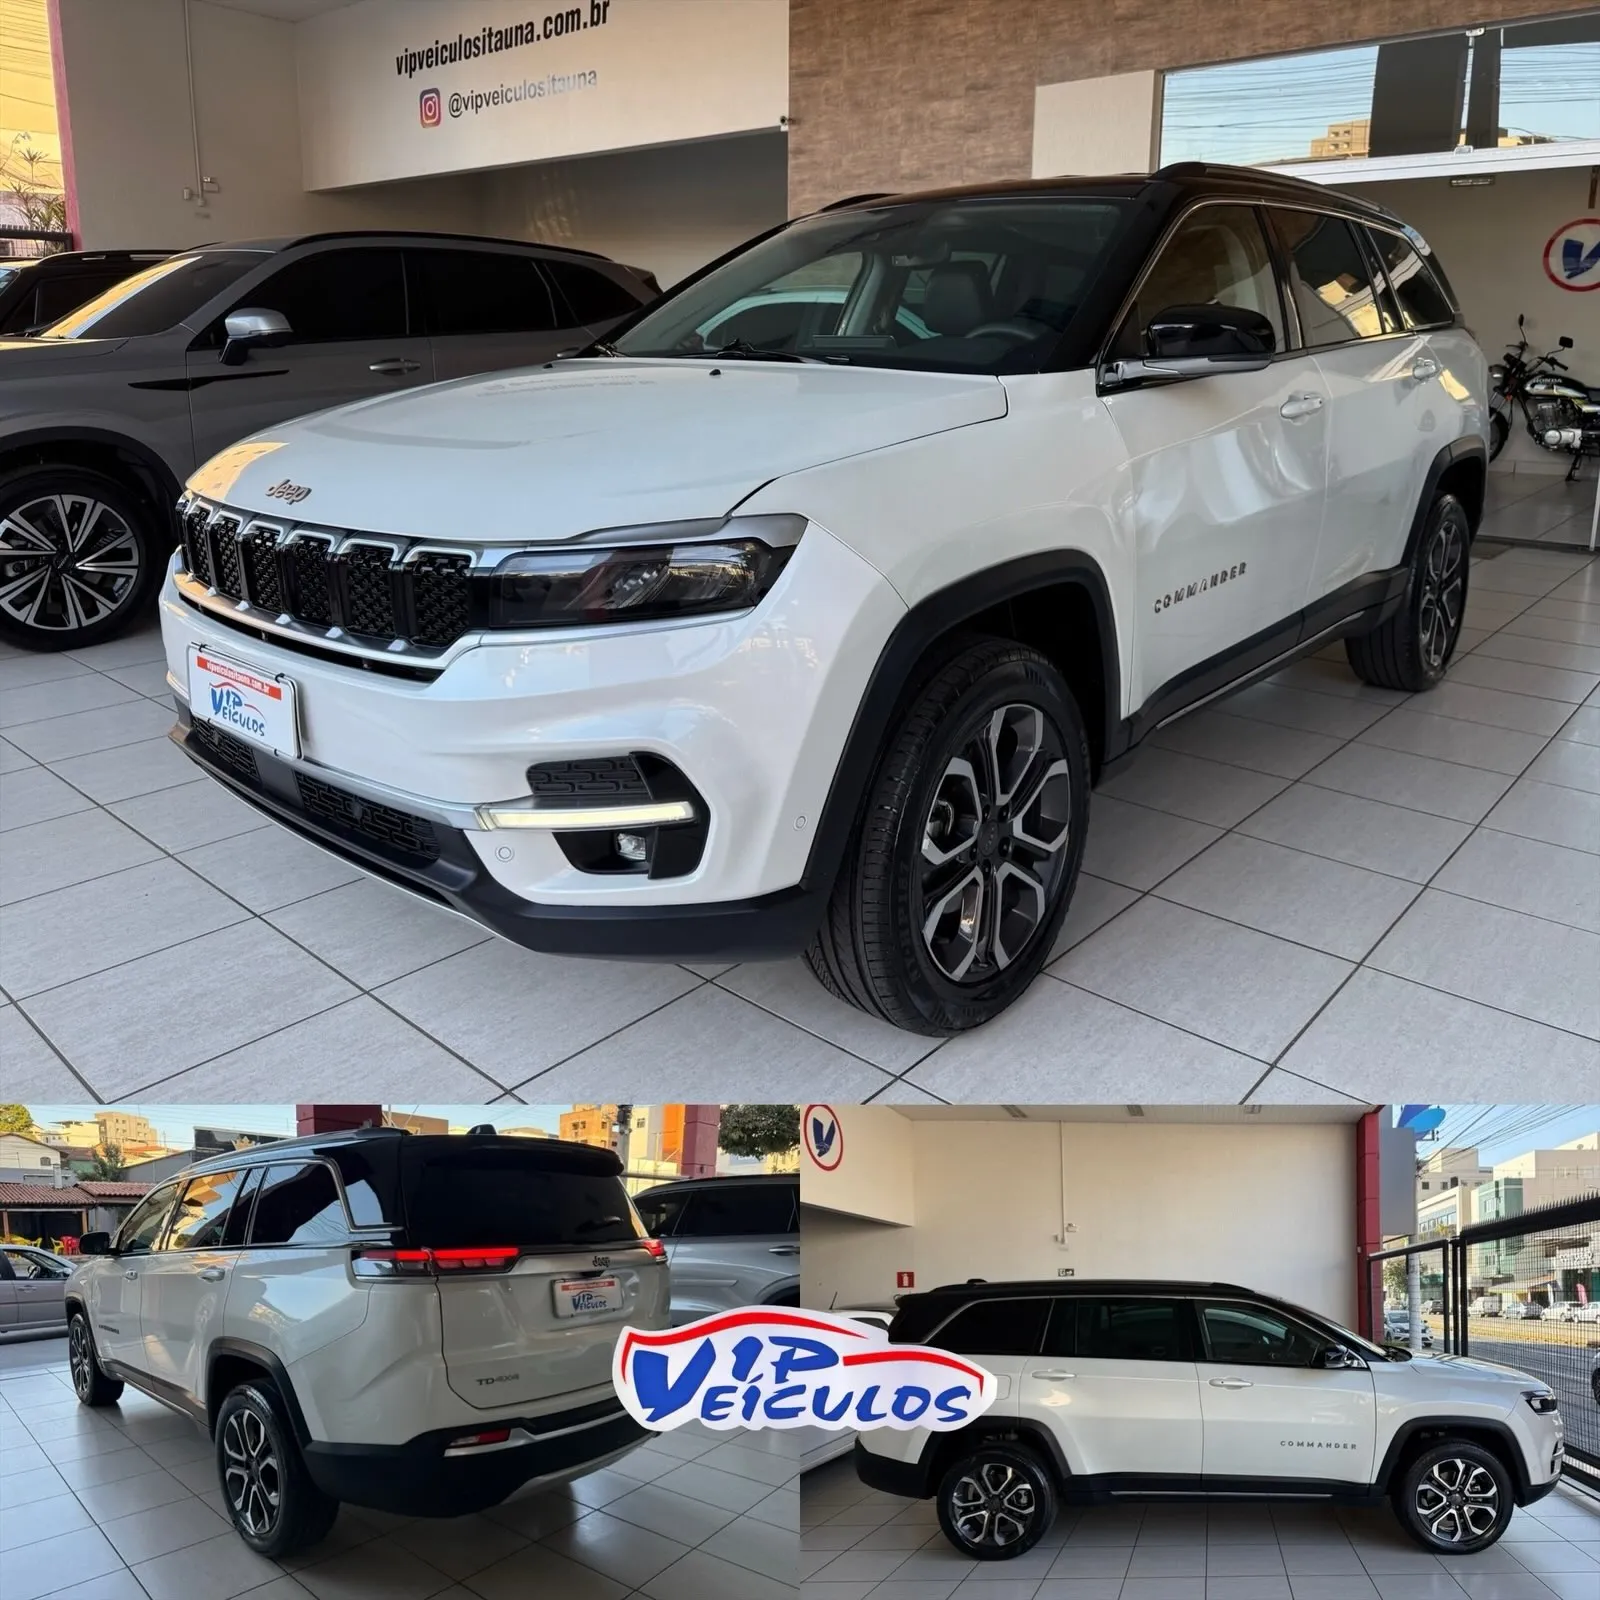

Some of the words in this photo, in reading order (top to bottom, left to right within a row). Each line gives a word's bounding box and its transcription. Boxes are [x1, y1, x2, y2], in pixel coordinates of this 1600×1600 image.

[396, 0, 610, 78] vipveiculositauna.com.br
[449, 69, 597, 118] @vipveiculositauna
[1154, 561, 1247, 613] COMMANDER
[211, 688, 243, 715] VIP
[1279, 1440, 1357, 1450] COMMANDER
